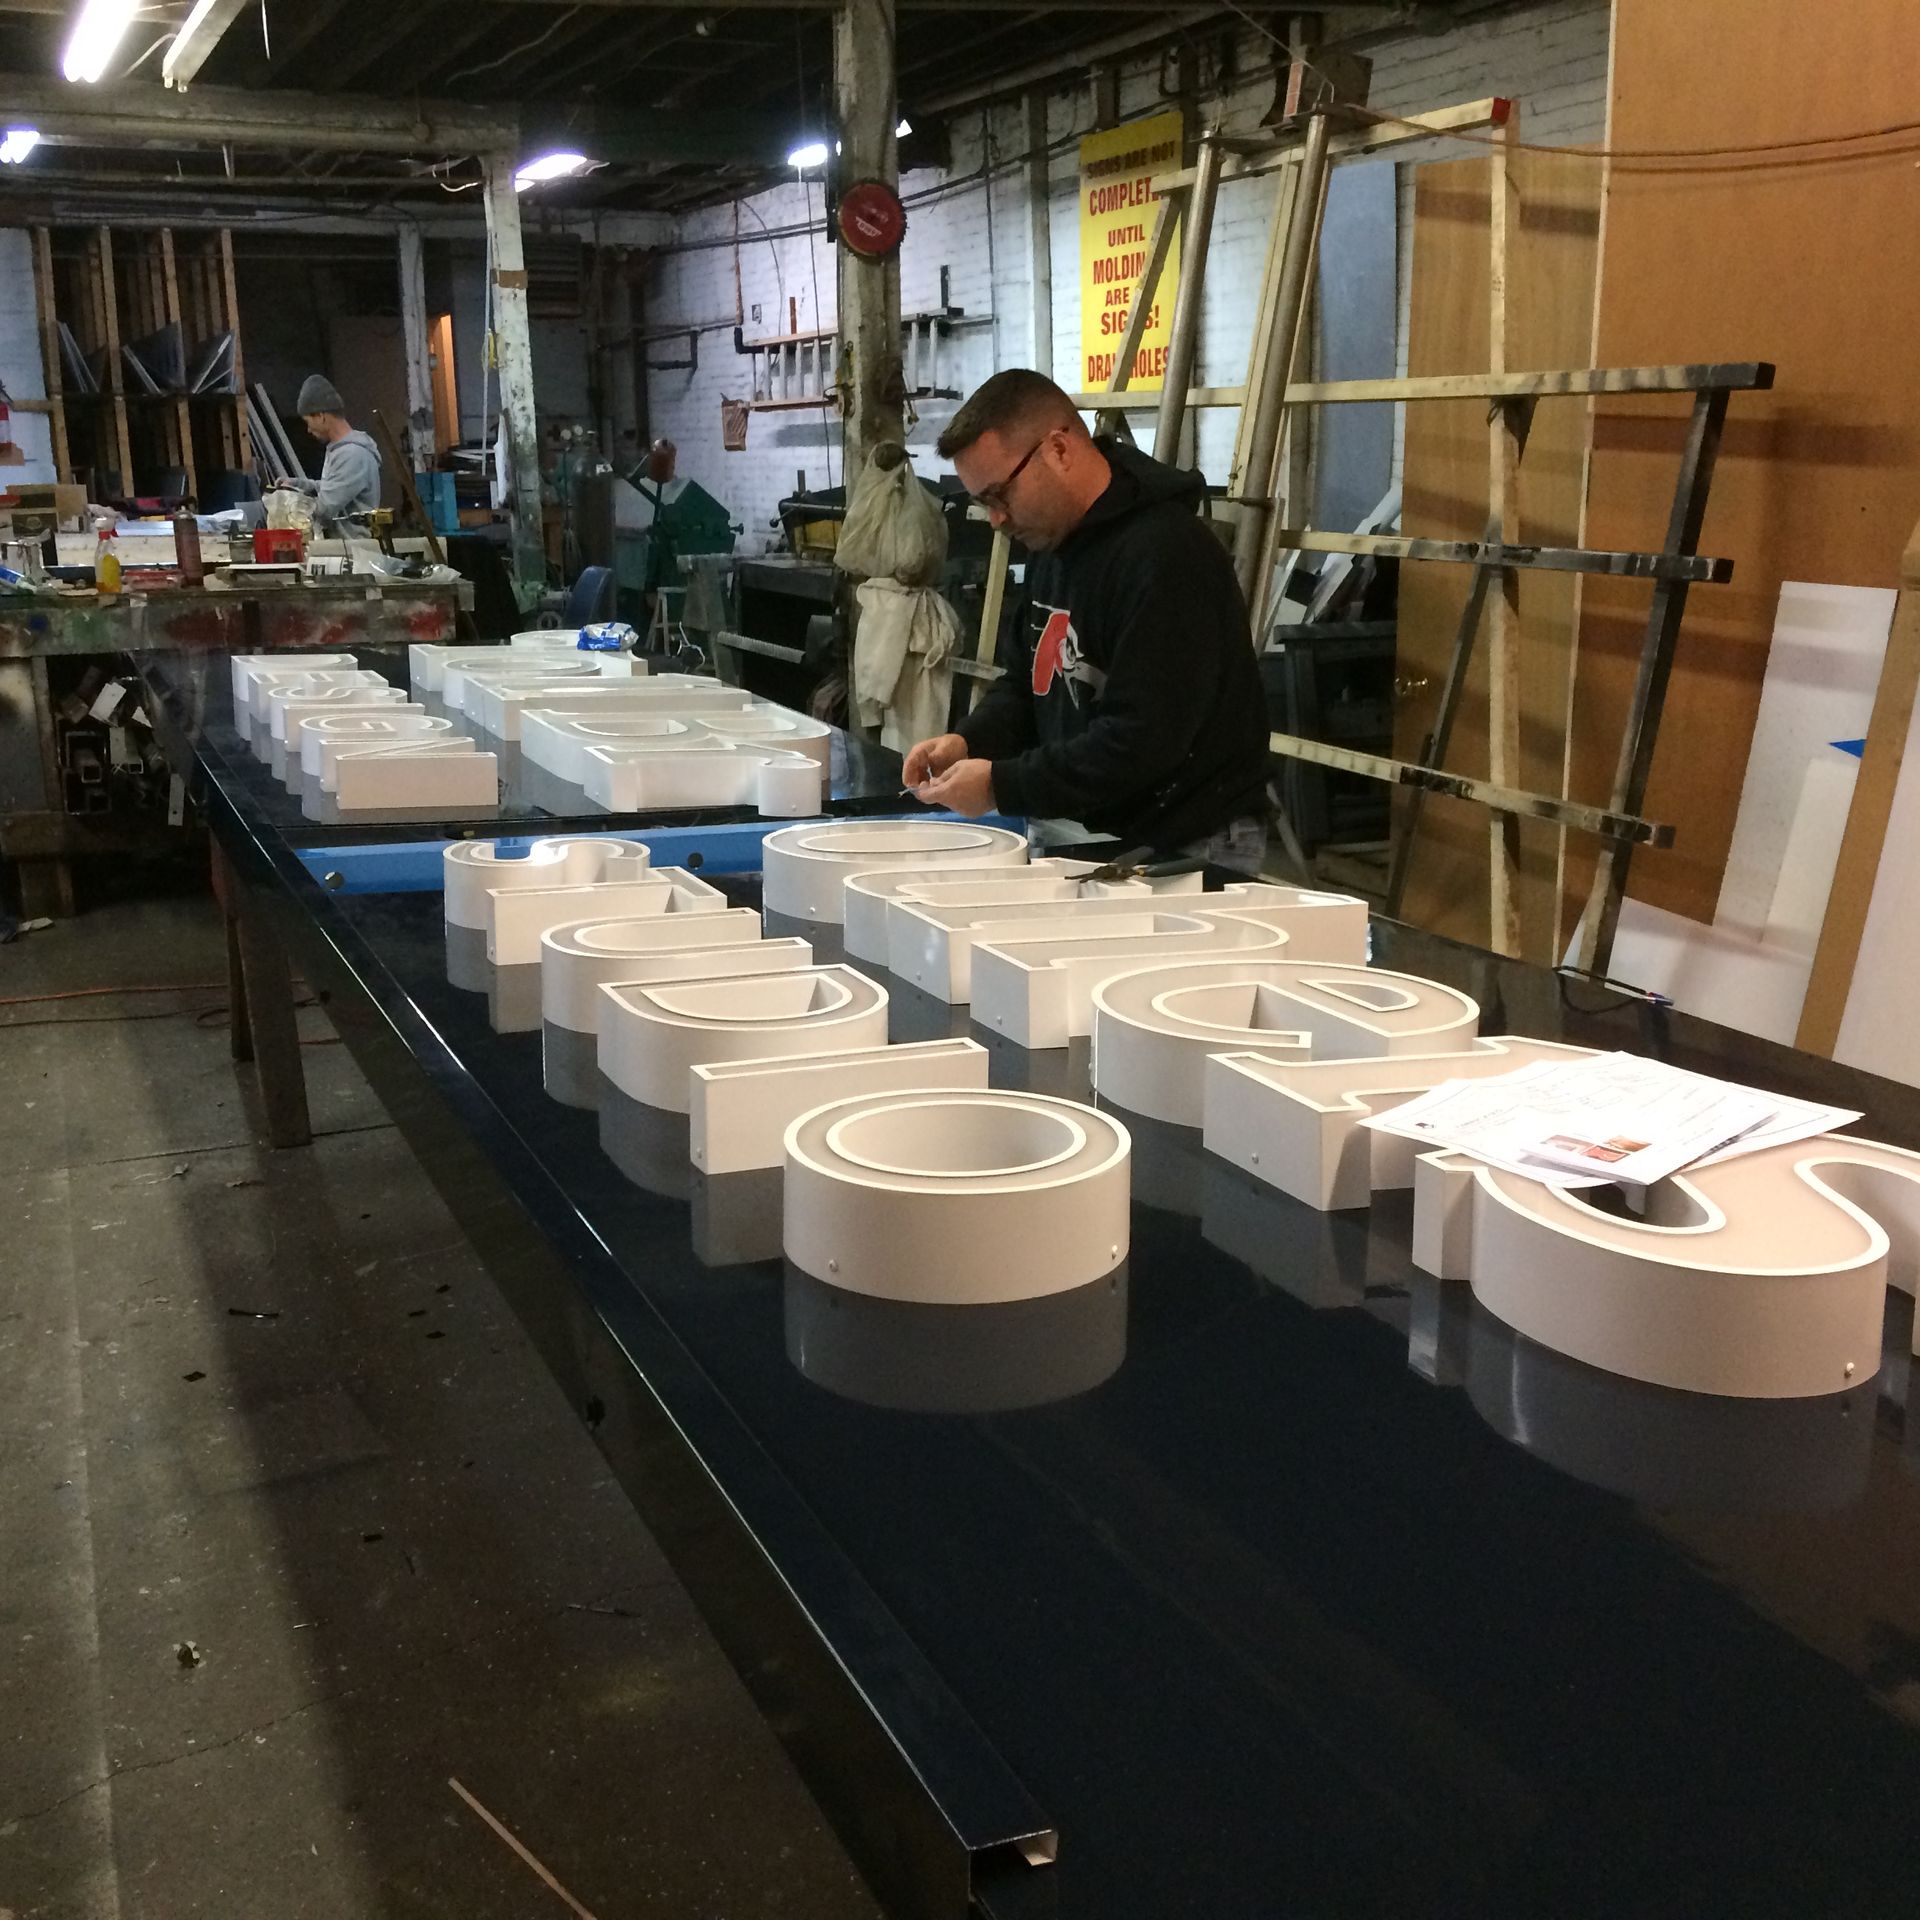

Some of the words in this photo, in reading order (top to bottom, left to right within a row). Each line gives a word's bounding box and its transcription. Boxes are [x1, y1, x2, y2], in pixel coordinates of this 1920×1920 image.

[1124, 147, 1147, 170] ARE
[1151, 141, 1175, 163] NOT
[1090, 176, 1163, 216] COMPLET
[1108, 224, 1145, 247] UNTIL
[1093, 251, 1146, 285] MOLDIN
[1105, 287, 1129, 306] ARE
[1101, 304, 1159, 335] SIGS!
[1088, 352, 1116, 382] DRA
